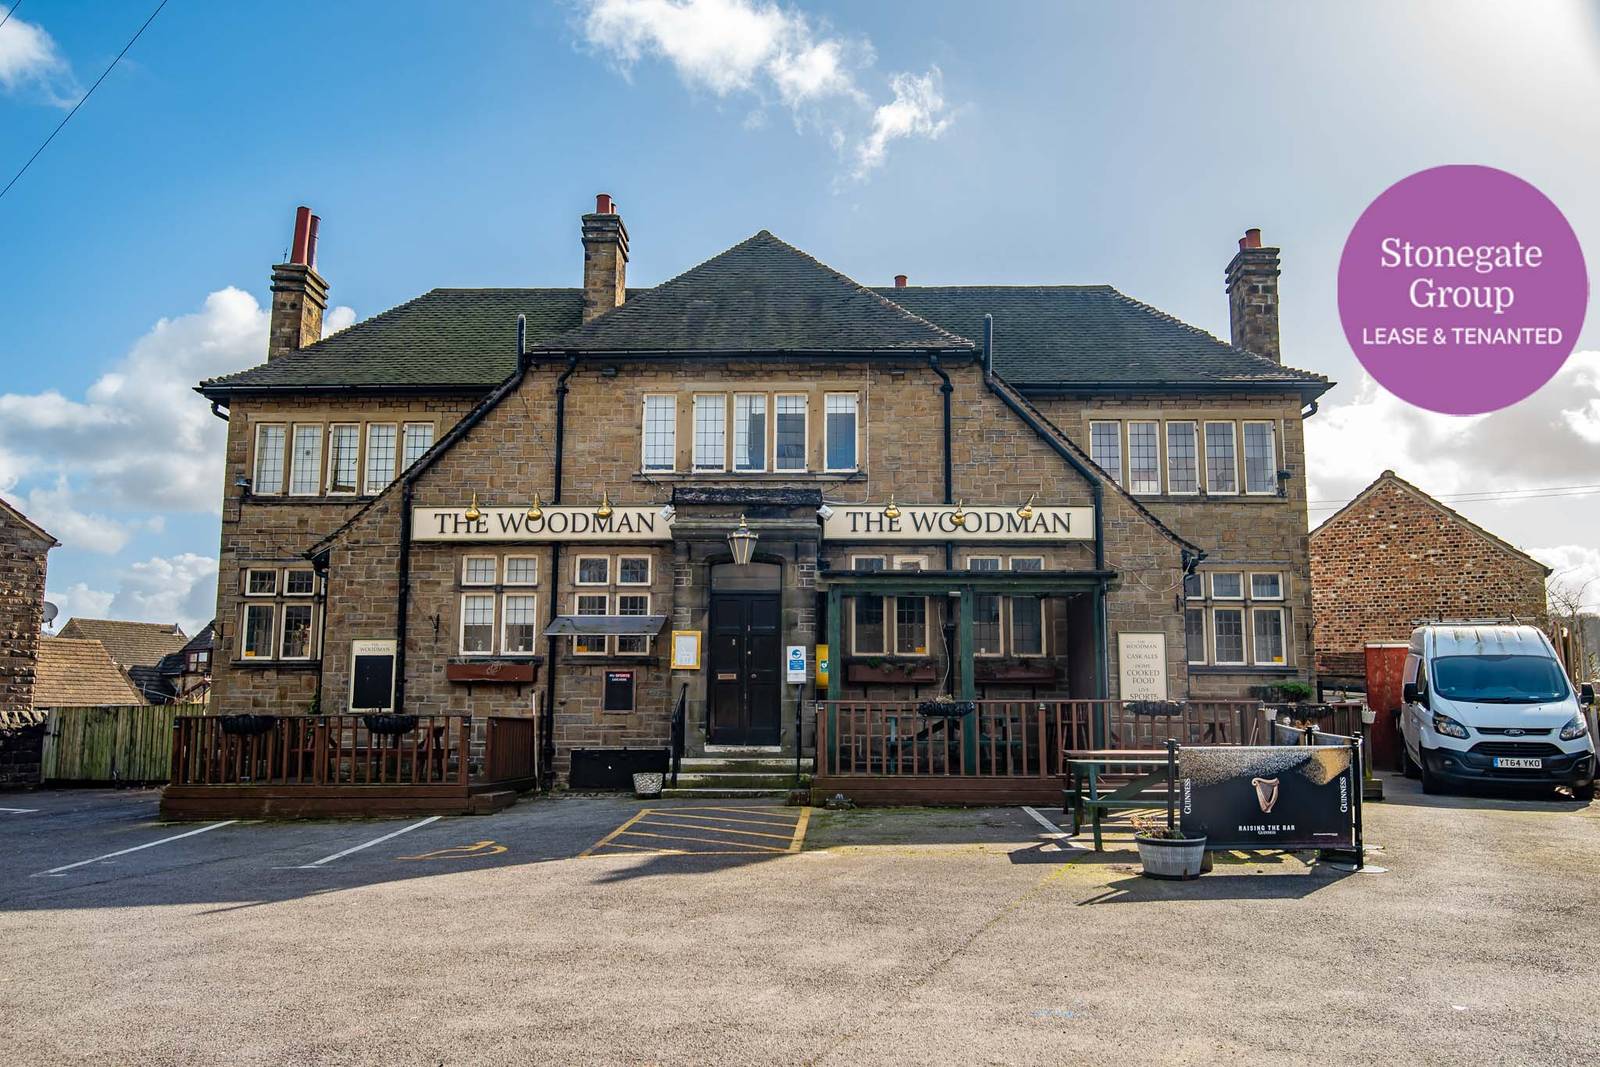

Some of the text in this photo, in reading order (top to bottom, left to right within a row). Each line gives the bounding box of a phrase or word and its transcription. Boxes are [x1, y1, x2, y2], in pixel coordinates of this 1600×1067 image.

[434, 512, 655, 534] THE WOODMAN
[846, 511, 1071, 533] THE WOODMAN
[1184, 778, 1192, 815] GUINNESS
[1340, 776, 1348, 813] GUINNESS
